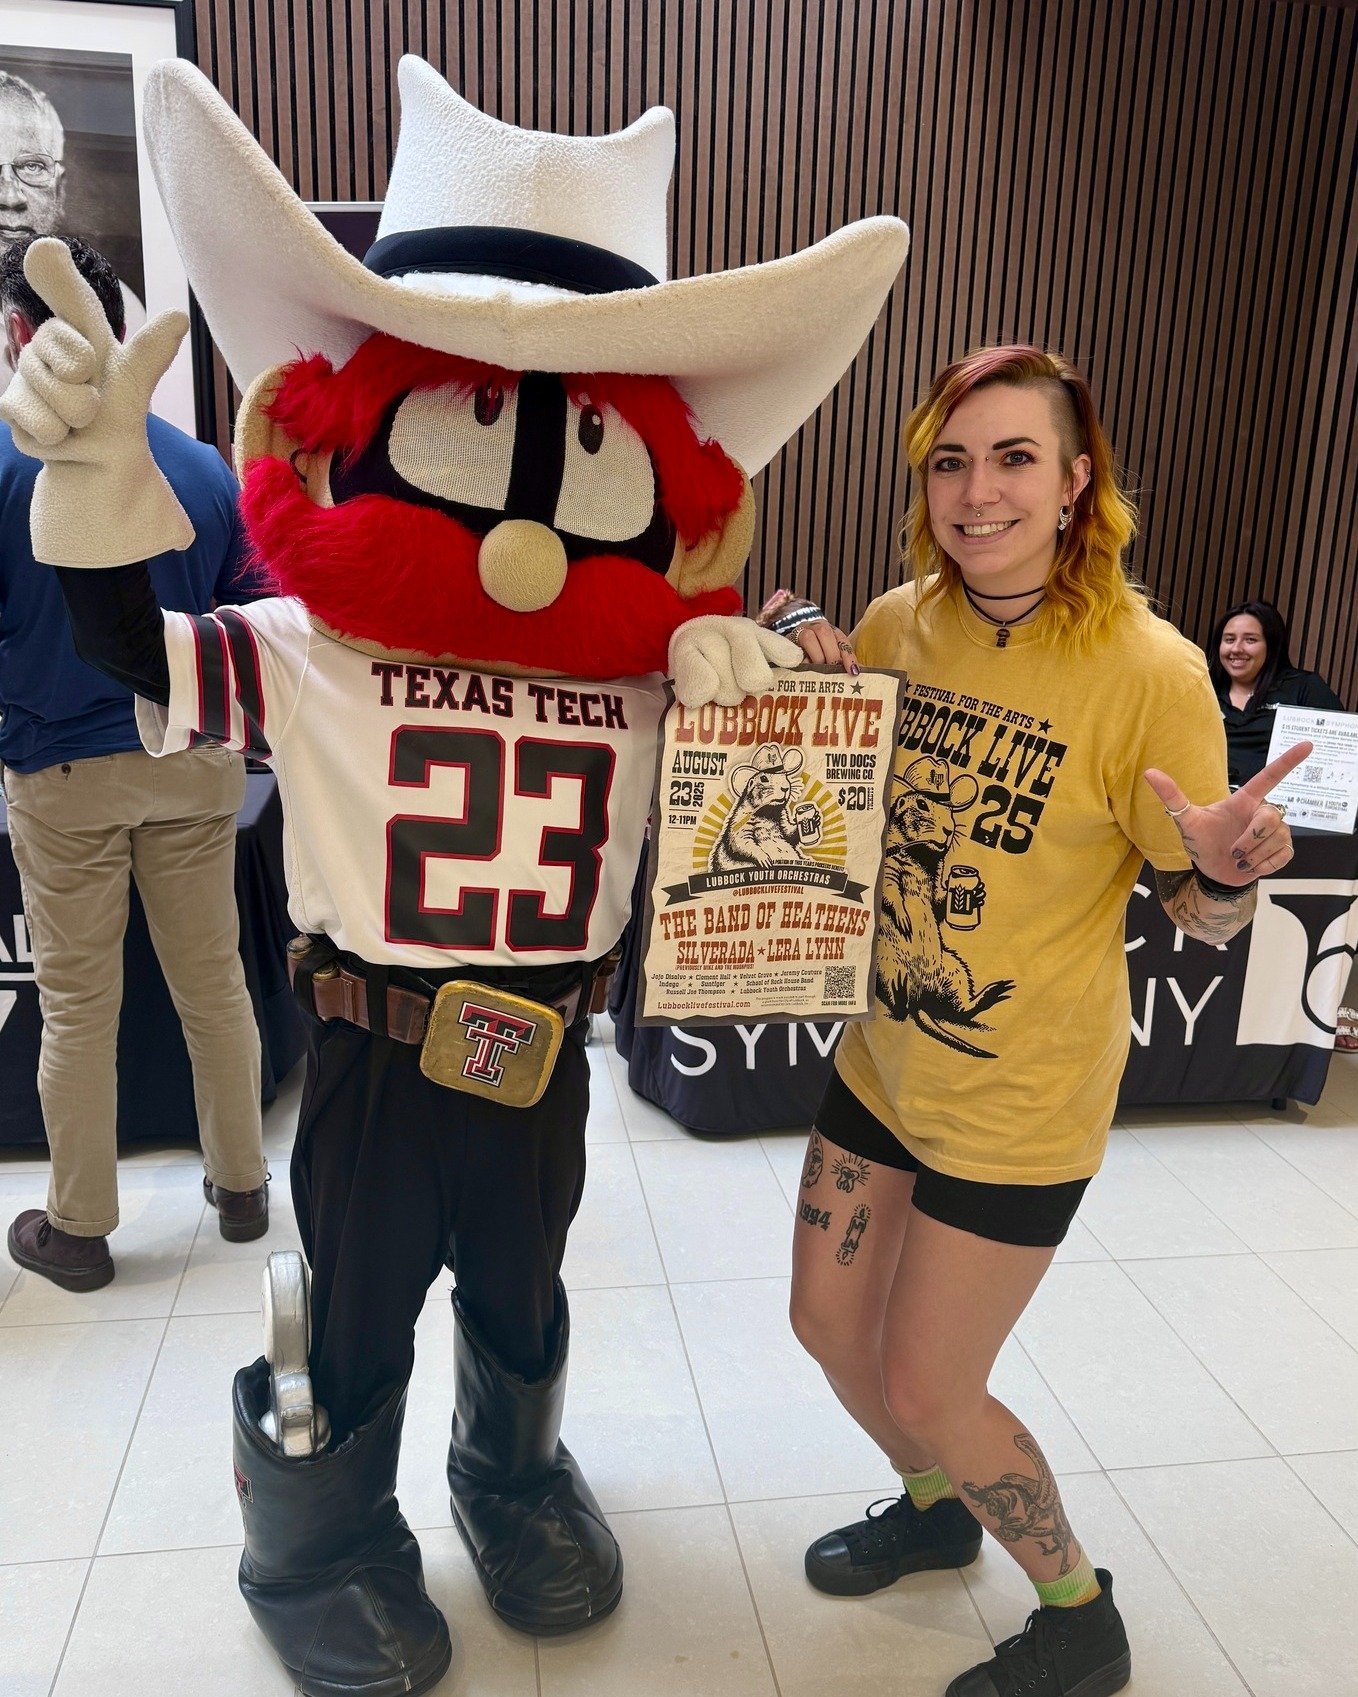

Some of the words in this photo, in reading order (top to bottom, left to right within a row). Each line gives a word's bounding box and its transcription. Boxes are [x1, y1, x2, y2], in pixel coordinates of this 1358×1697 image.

[371, 661, 514, 718] TEXAS
[527, 683, 629, 730] TECH
[777, 680, 796, 692] FOR
[799, 680, 816, 693] THE
[818, 682, 845, 694] ARTS
[913, 684, 956, 704] FESTIVAL
[957, 694, 980, 711] FOR
[980, 700, 1004, 718] THE
[1002, 709, 1035, 730] ARTS
[675, 695, 808, 747] LUBBOCK
[812, 696, 884, 748] LIVE
[672, 750, 728, 776] AUGUST
[826, 753, 848, 768] TWO
[850, 754, 876, 768] DOCS
[826, 768, 861, 780] BREWING
[862, 769, 875, 780] CO.
[976, 724, 1068, 798] LIVE
[669, 780, 693, 806] 23
[693, 781, 705, 808] 2025
[838, 786, 866, 811] $20
[668, 814, 697, 825] 12-11PM
[970, 784, 1046, 855] 25
[384, 724, 617, 952] 23
[706, 874, 746, 888] LUBBOCK
[748, 871, 775, 884] YOUTH
[777, 870, 831, 885] ORCHESTRAS
[732, 885, 804, 896] @LUBBOCKLIVEFESTIVAL
[660, 908, 697, 940] THE
[704, 903, 751, 934] BAND
[756, 902, 776, 930] OF
[780, 901, 871, 937] HEATHENS
[676, 940, 755, 965] SILVERADA
[766, 938, 801, 962] LERA
[805, 937, 846, 960] LYNN
[658, 1000, 751, 1009] Lubbocklivefestival.com
[800, 1198, 832, 1232] 1994
